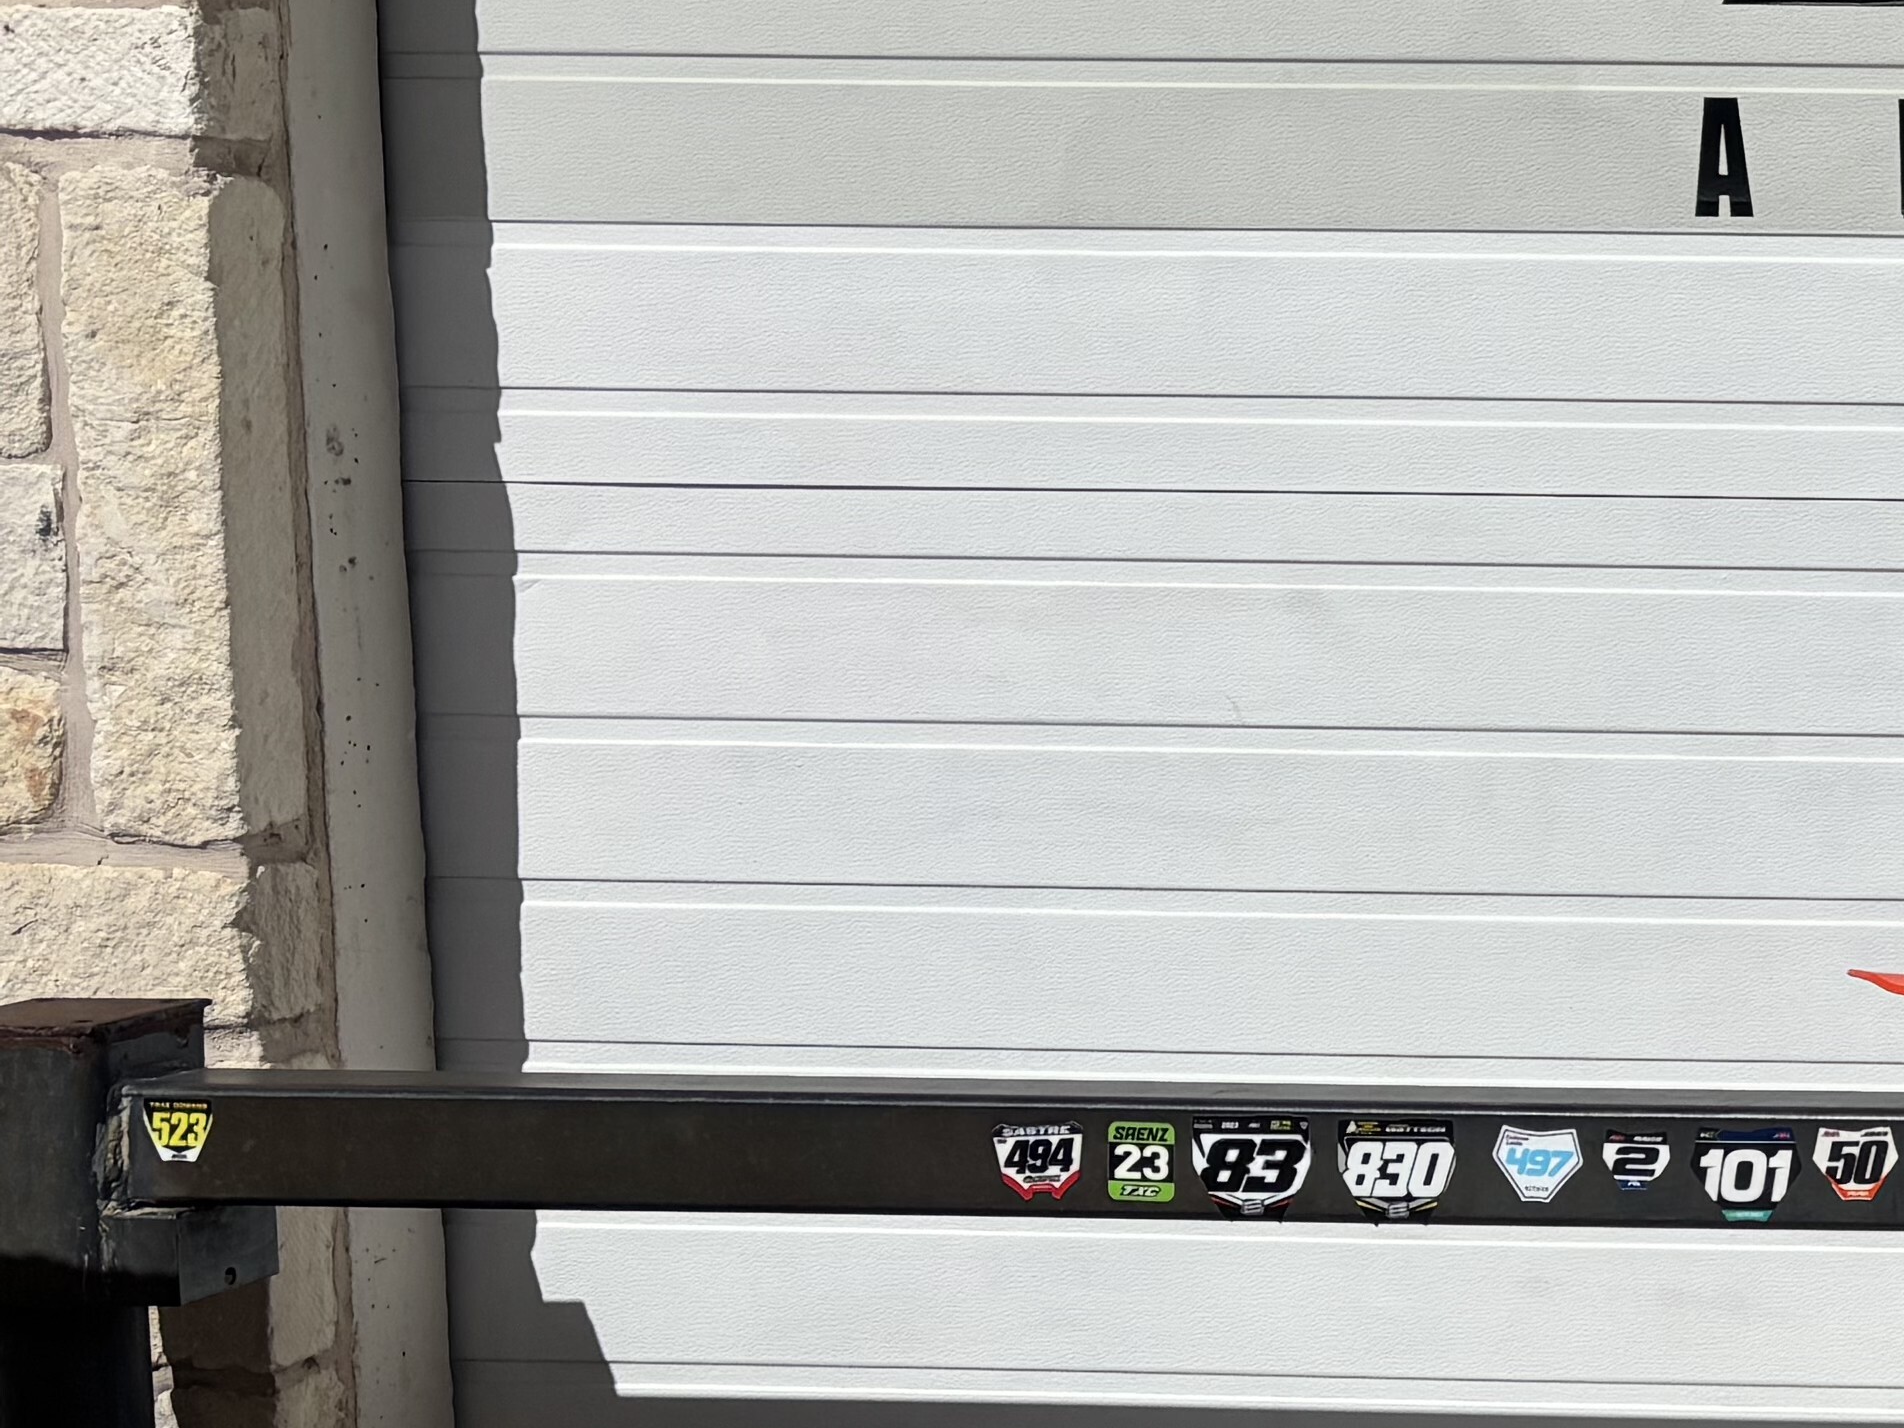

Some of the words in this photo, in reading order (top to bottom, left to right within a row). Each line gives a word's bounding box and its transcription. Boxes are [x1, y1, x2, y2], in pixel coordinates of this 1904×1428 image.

[152, 1112, 206, 1146] 523
[1113, 1126, 1169, 1141] SAENZ
[1004, 1138, 1074, 1174] 494
[1114, 1143, 1169, 1180] 23
[1200, 1138, 1307, 1193] 83
[1342, 1141, 1455, 1197] 830
[1506, 1147, 1574, 1177] 497
[1612, 1146, 1660, 1177] 2
[1825, 1140, 1888, 1184] 50
[1700, 1149, 1793, 1202] 101
